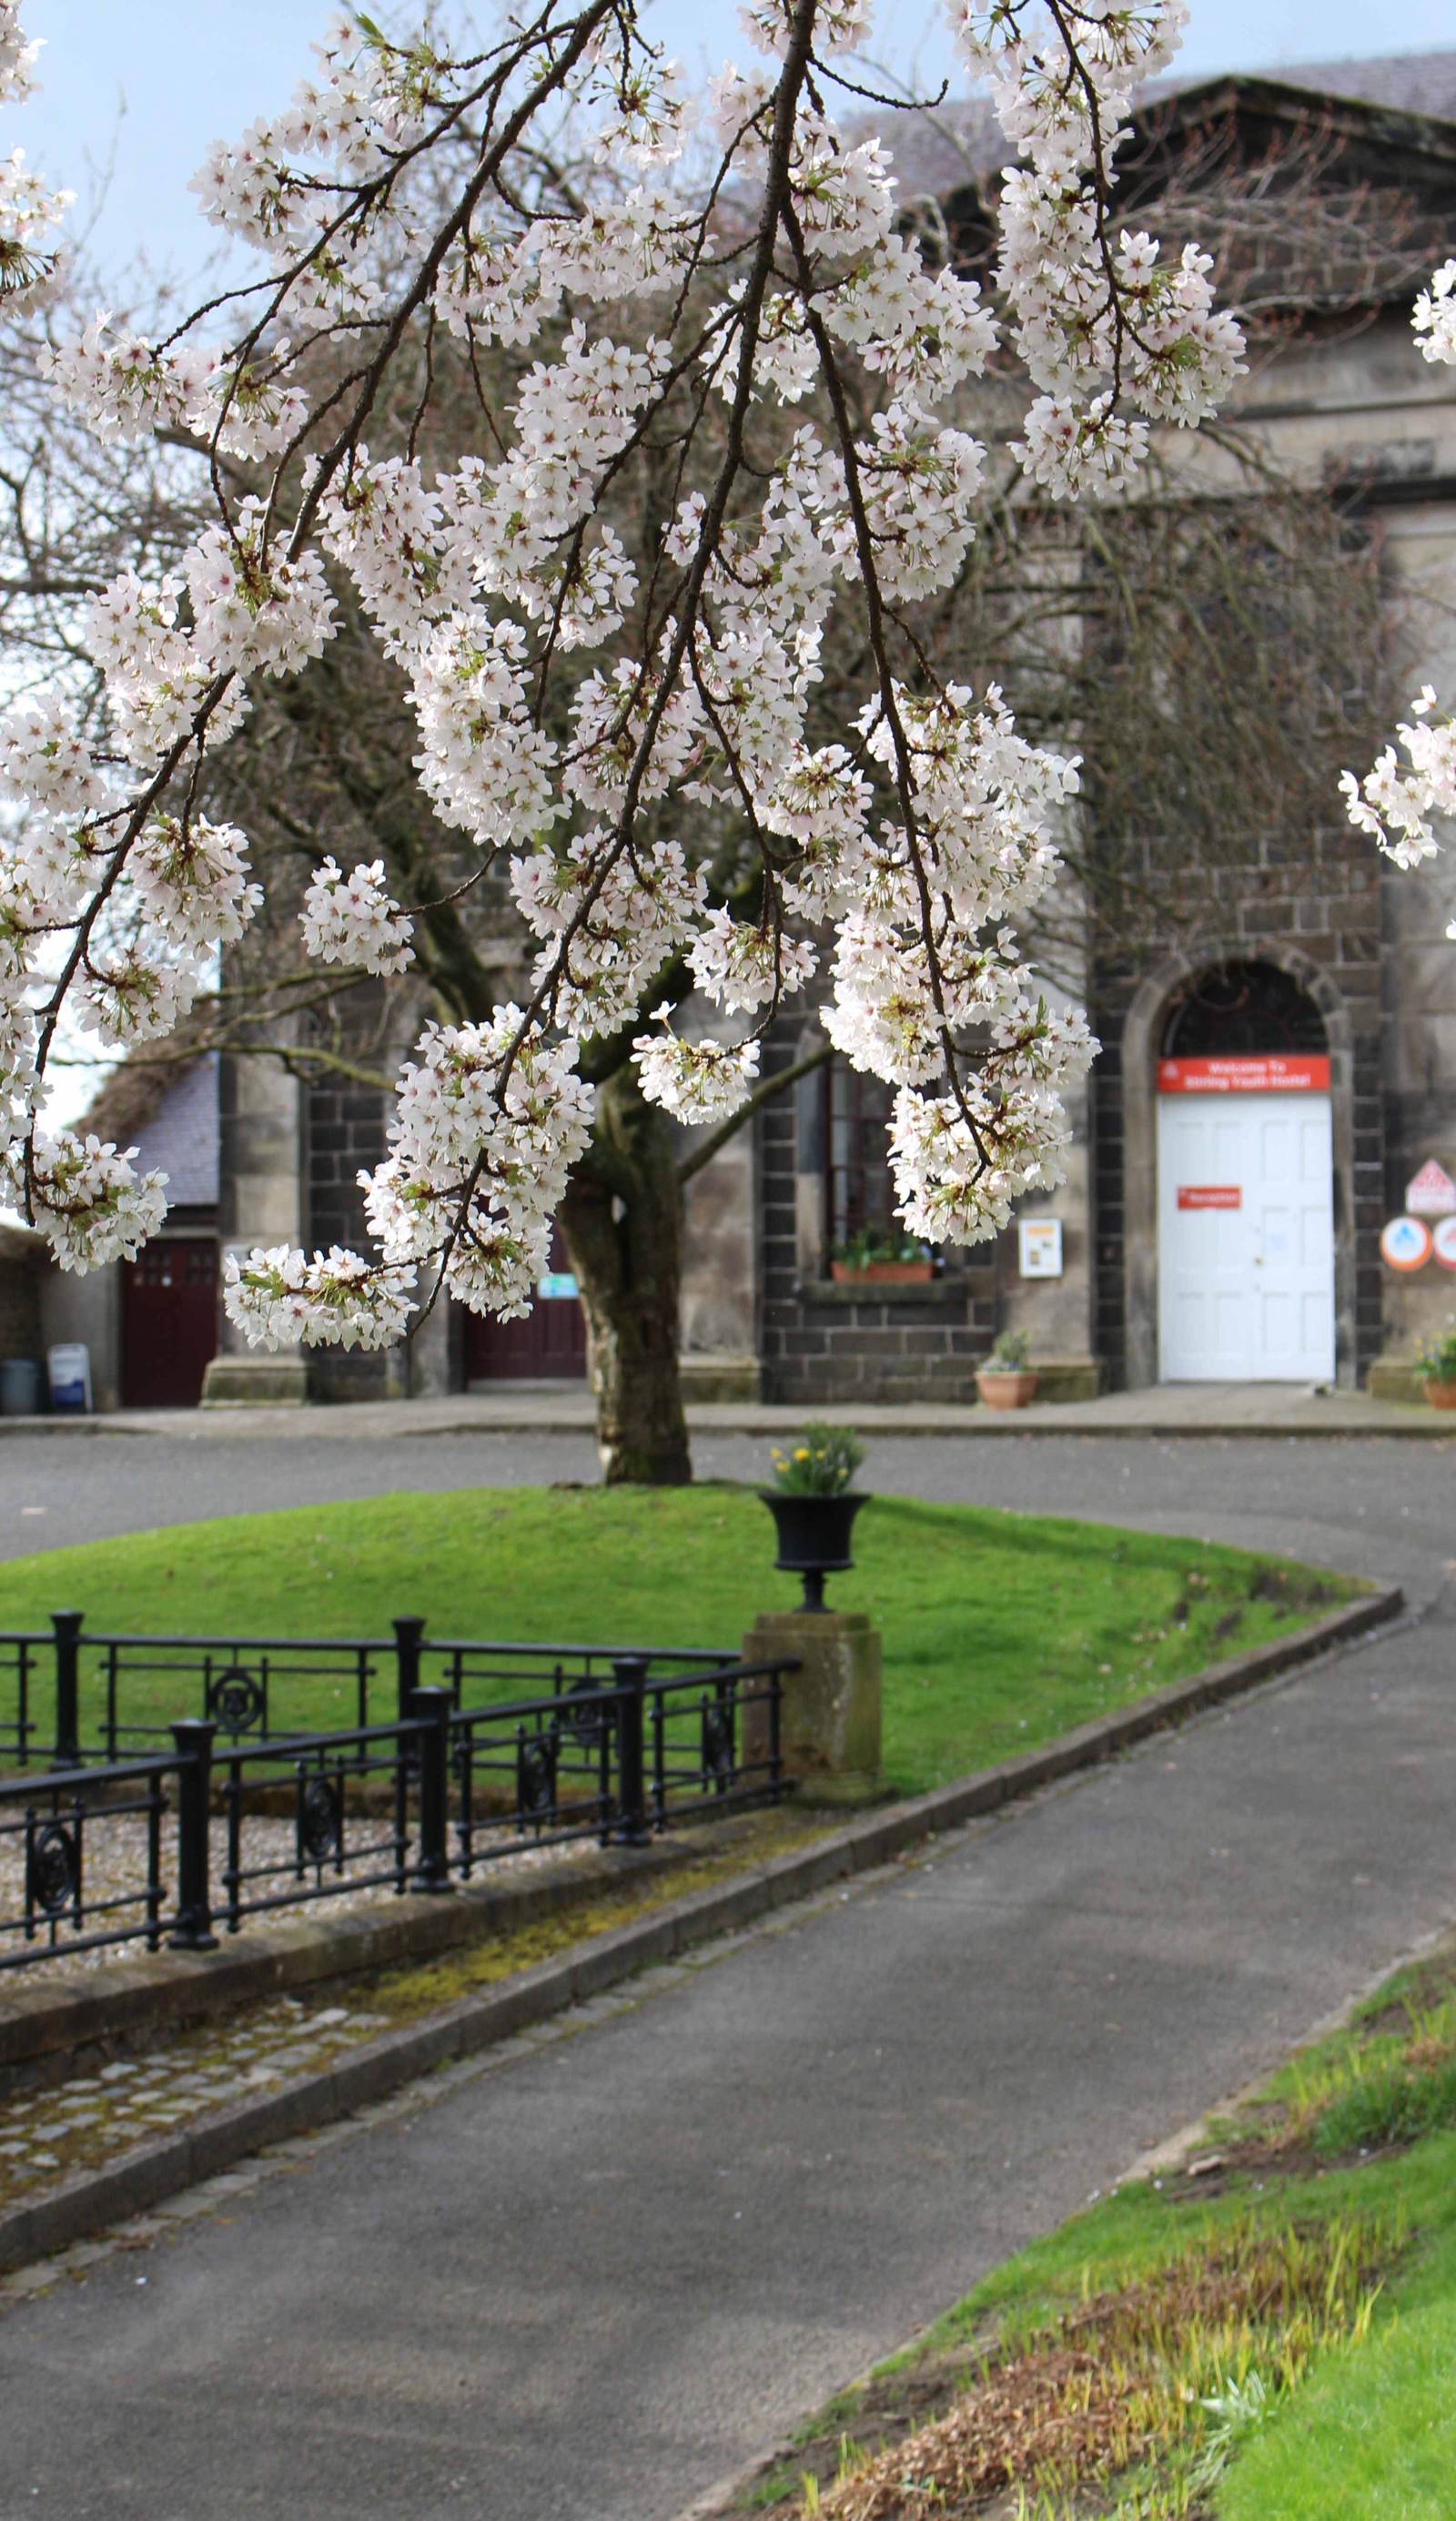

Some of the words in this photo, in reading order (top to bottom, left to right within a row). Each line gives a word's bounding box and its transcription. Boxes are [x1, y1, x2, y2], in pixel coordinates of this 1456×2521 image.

[1208, 1061, 1267, 1073] Welcome
[1269, 1060, 1286, 1073] To
[1232, 1075, 1268, 1087] Youth
